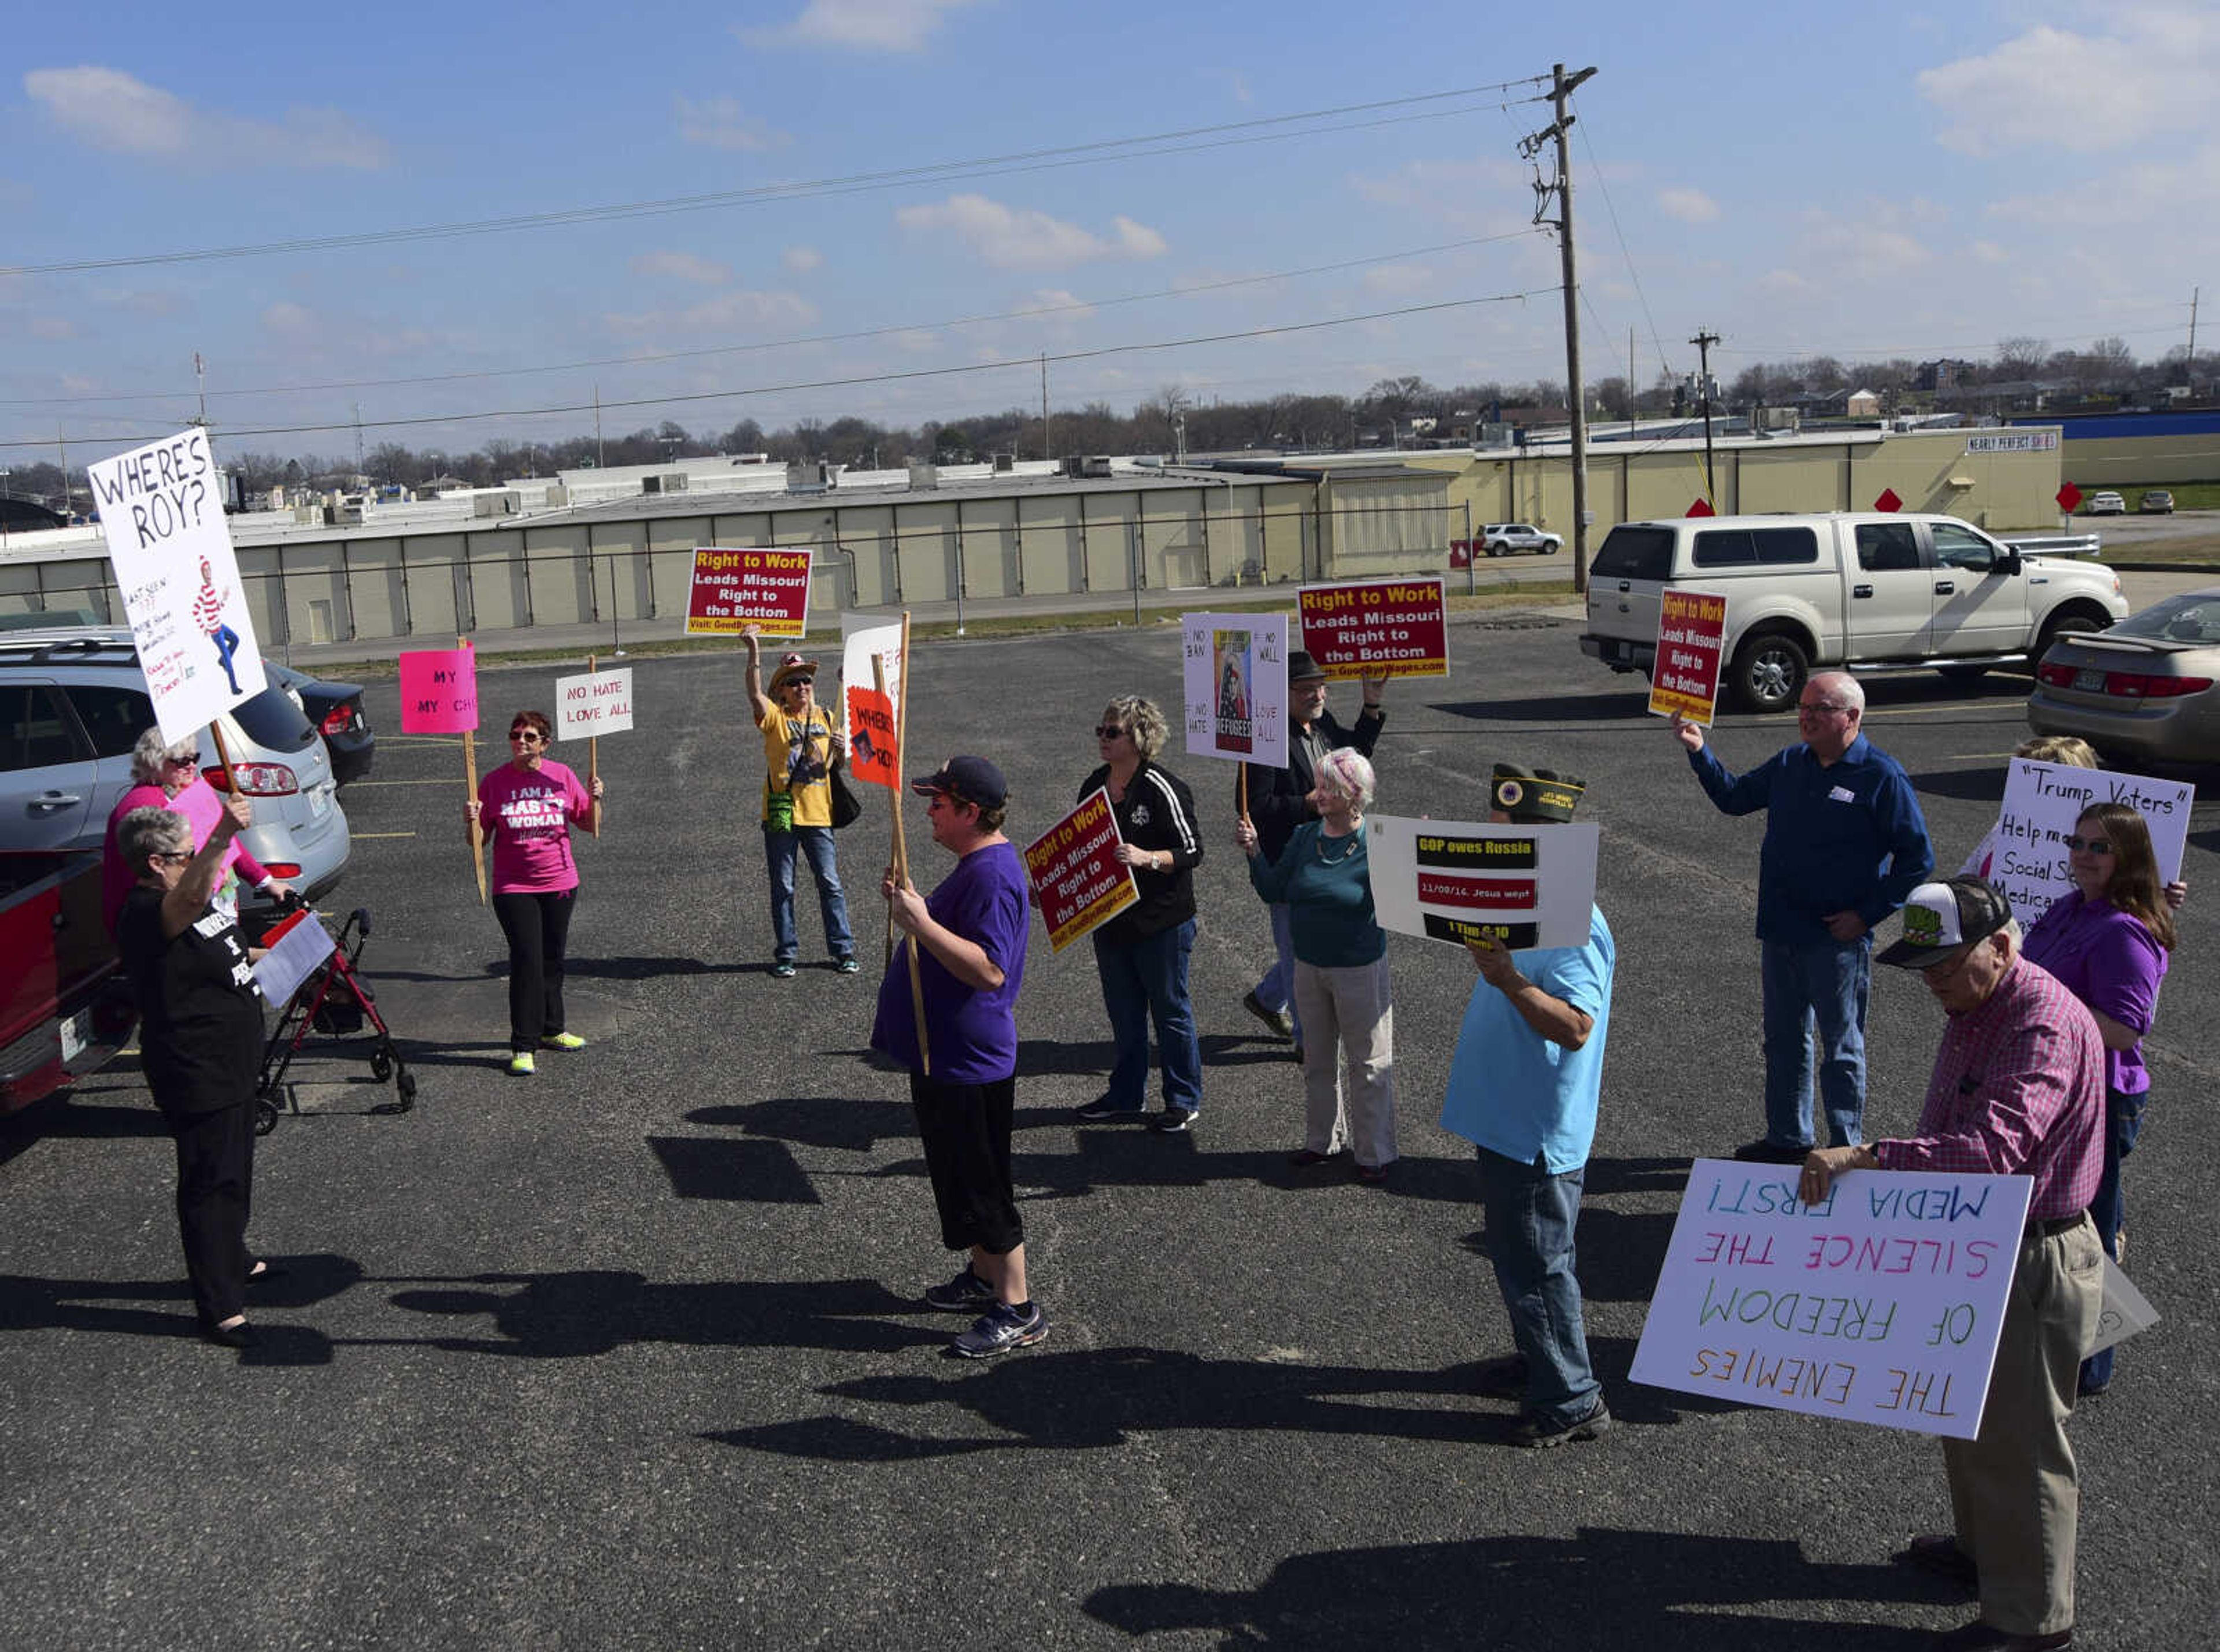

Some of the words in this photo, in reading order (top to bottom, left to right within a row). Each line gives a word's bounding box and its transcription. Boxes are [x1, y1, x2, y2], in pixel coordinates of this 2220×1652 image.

[92, 436, 206, 505] WHERE'S
[132, 480, 205, 549] ROY?
[697, 553, 739, 570] Right
[744, 554, 760, 568] to
[765, 554, 806, 569] Work
[695, 573, 739, 586] Leads
[743, 574, 806, 587] Missouri
[719, 588, 757, 603] Right
[763, 590, 778, 602] to
[1302, 590, 1355, 611] Right
[1360, 590, 1381, 605] to
[1387, 585, 1439, 603] Work
[706, 605, 730, 616] the
[734, 605, 789, 618] Bottom
[1663, 594, 1687, 620] Right
[1688, 599, 1698, 618] to
[1700, 599, 1723, 623] Work
[1304, 614, 1358, 629] Leads
[1364, 609, 1441, 625] Missouri
[1193, 630, 1205, 643] NO
[1338, 629, 1385, 646] Right
[1390, 628, 1409, 641] to
[1660, 625, 1684, 644] Leads
[1686, 629, 1721, 650] Missouri
[1187, 644, 1205, 658] BAN
[1260, 646, 1280, 663] WALL
[1325, 650, 1354, 662] the
[1360, 646, 1425, 661] Bottom
[1671, 649, 1692, 671] Right
[1694, 655, 1703, 670] to
[434, 671, 456, 683] MY
[1662, 671, 1676, 689] the
[1677, 675, 1707, 695] Bottom
[568, 687, 586, 700] NO
[594, 681, 623, 697] HATE
[418, 700, 438, 713] MY
[567, 708, 600, 722] LOVE
[610, 702, 632, 717] ALL
[1255, 699, 1277, 719] LOVE
[1189, 720, 1208, 734] HATE
[511, 790, 517, 799] I
[520, 787, 541, 799] AM
[543, 787, 555, 798] A
[2023, 765, 2093, 810] "Trump
[2110, 780, 2188, 814] Voters"
[501, 798, 565, 816] NASTY
[506, 814, 565, 829] WOMAN
[2001, 814, 2040, 847] Help
[1027, 838, 1060, 869] Right
[1059, 829, 1073, 844] to
[1072, 799, 1108, 833] Work
[1419, 838, 1445, 851] GOP
[1448, 842, 1483, 854] owes
[1485, 840, 1532, 854] Russia
[1035, 861, 1067, 891] Leads
[1067, 823, 1115, 867] Missouri
[2001, 851, 2051, 881] Social
[1057, 866, 1087, 898] Right
[1088, 859, 1102, 876] to
[1056, 907, 1075, 925] the
[1075, 874, 1117, 911] Bottom
[1472, 889, 1501, 899] Jesus
[1448, 921, 1455, 932] 1
[1456, 922, 1481, 937] Tim
[1870, 1185, 1990, 1222] MEDIA
[1696, 1232, 1775, 1265] THE
[1805, 1235, 1998, 1278] SILENCE
[1700, 1277, 1897, 1341] FREEDOM
[1926, 1302, 1975, 1346] OF
[1689, 1349, 1856, 1405] ENEMIES
[1876, 1369, 1956, 1418] THE
